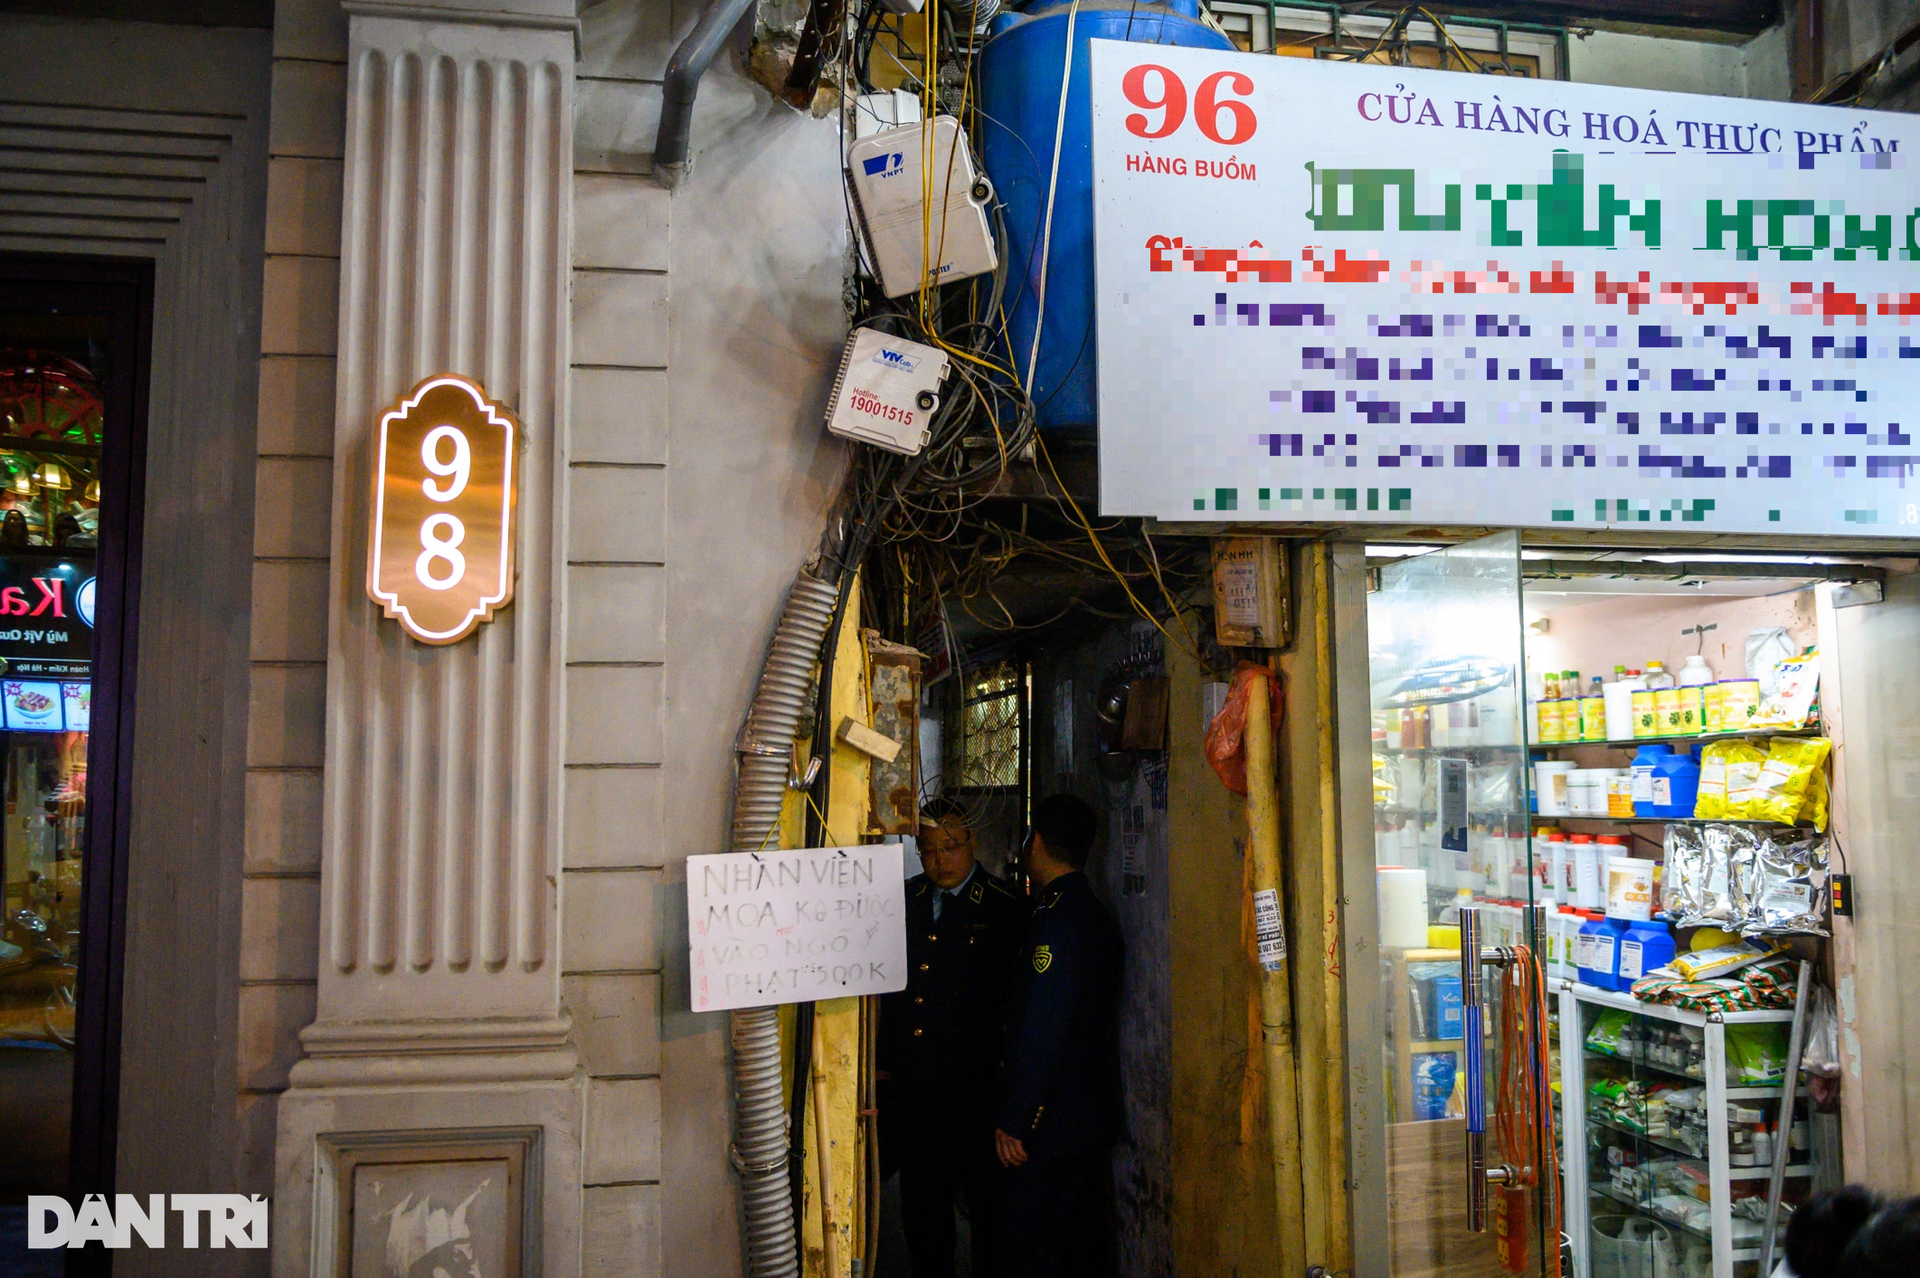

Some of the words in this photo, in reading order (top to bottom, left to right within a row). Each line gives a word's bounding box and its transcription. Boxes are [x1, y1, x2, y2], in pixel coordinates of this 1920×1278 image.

[1121, 63, 1258, 146] 96
[1357, 82, 1444, 127] CỬA
[1454, 94, 1571, 139] HÀNG
[1582, 108, 1668, 147] HOÁ
[881, 167, 905, 179] VNPT
[1126, 150, 1188, 177] HÀNG
[1194, 155, 1257, 182] BUỒM
[852, 386, 881, 402] Hotline:
[850, 395, 914, 426] 19001515
